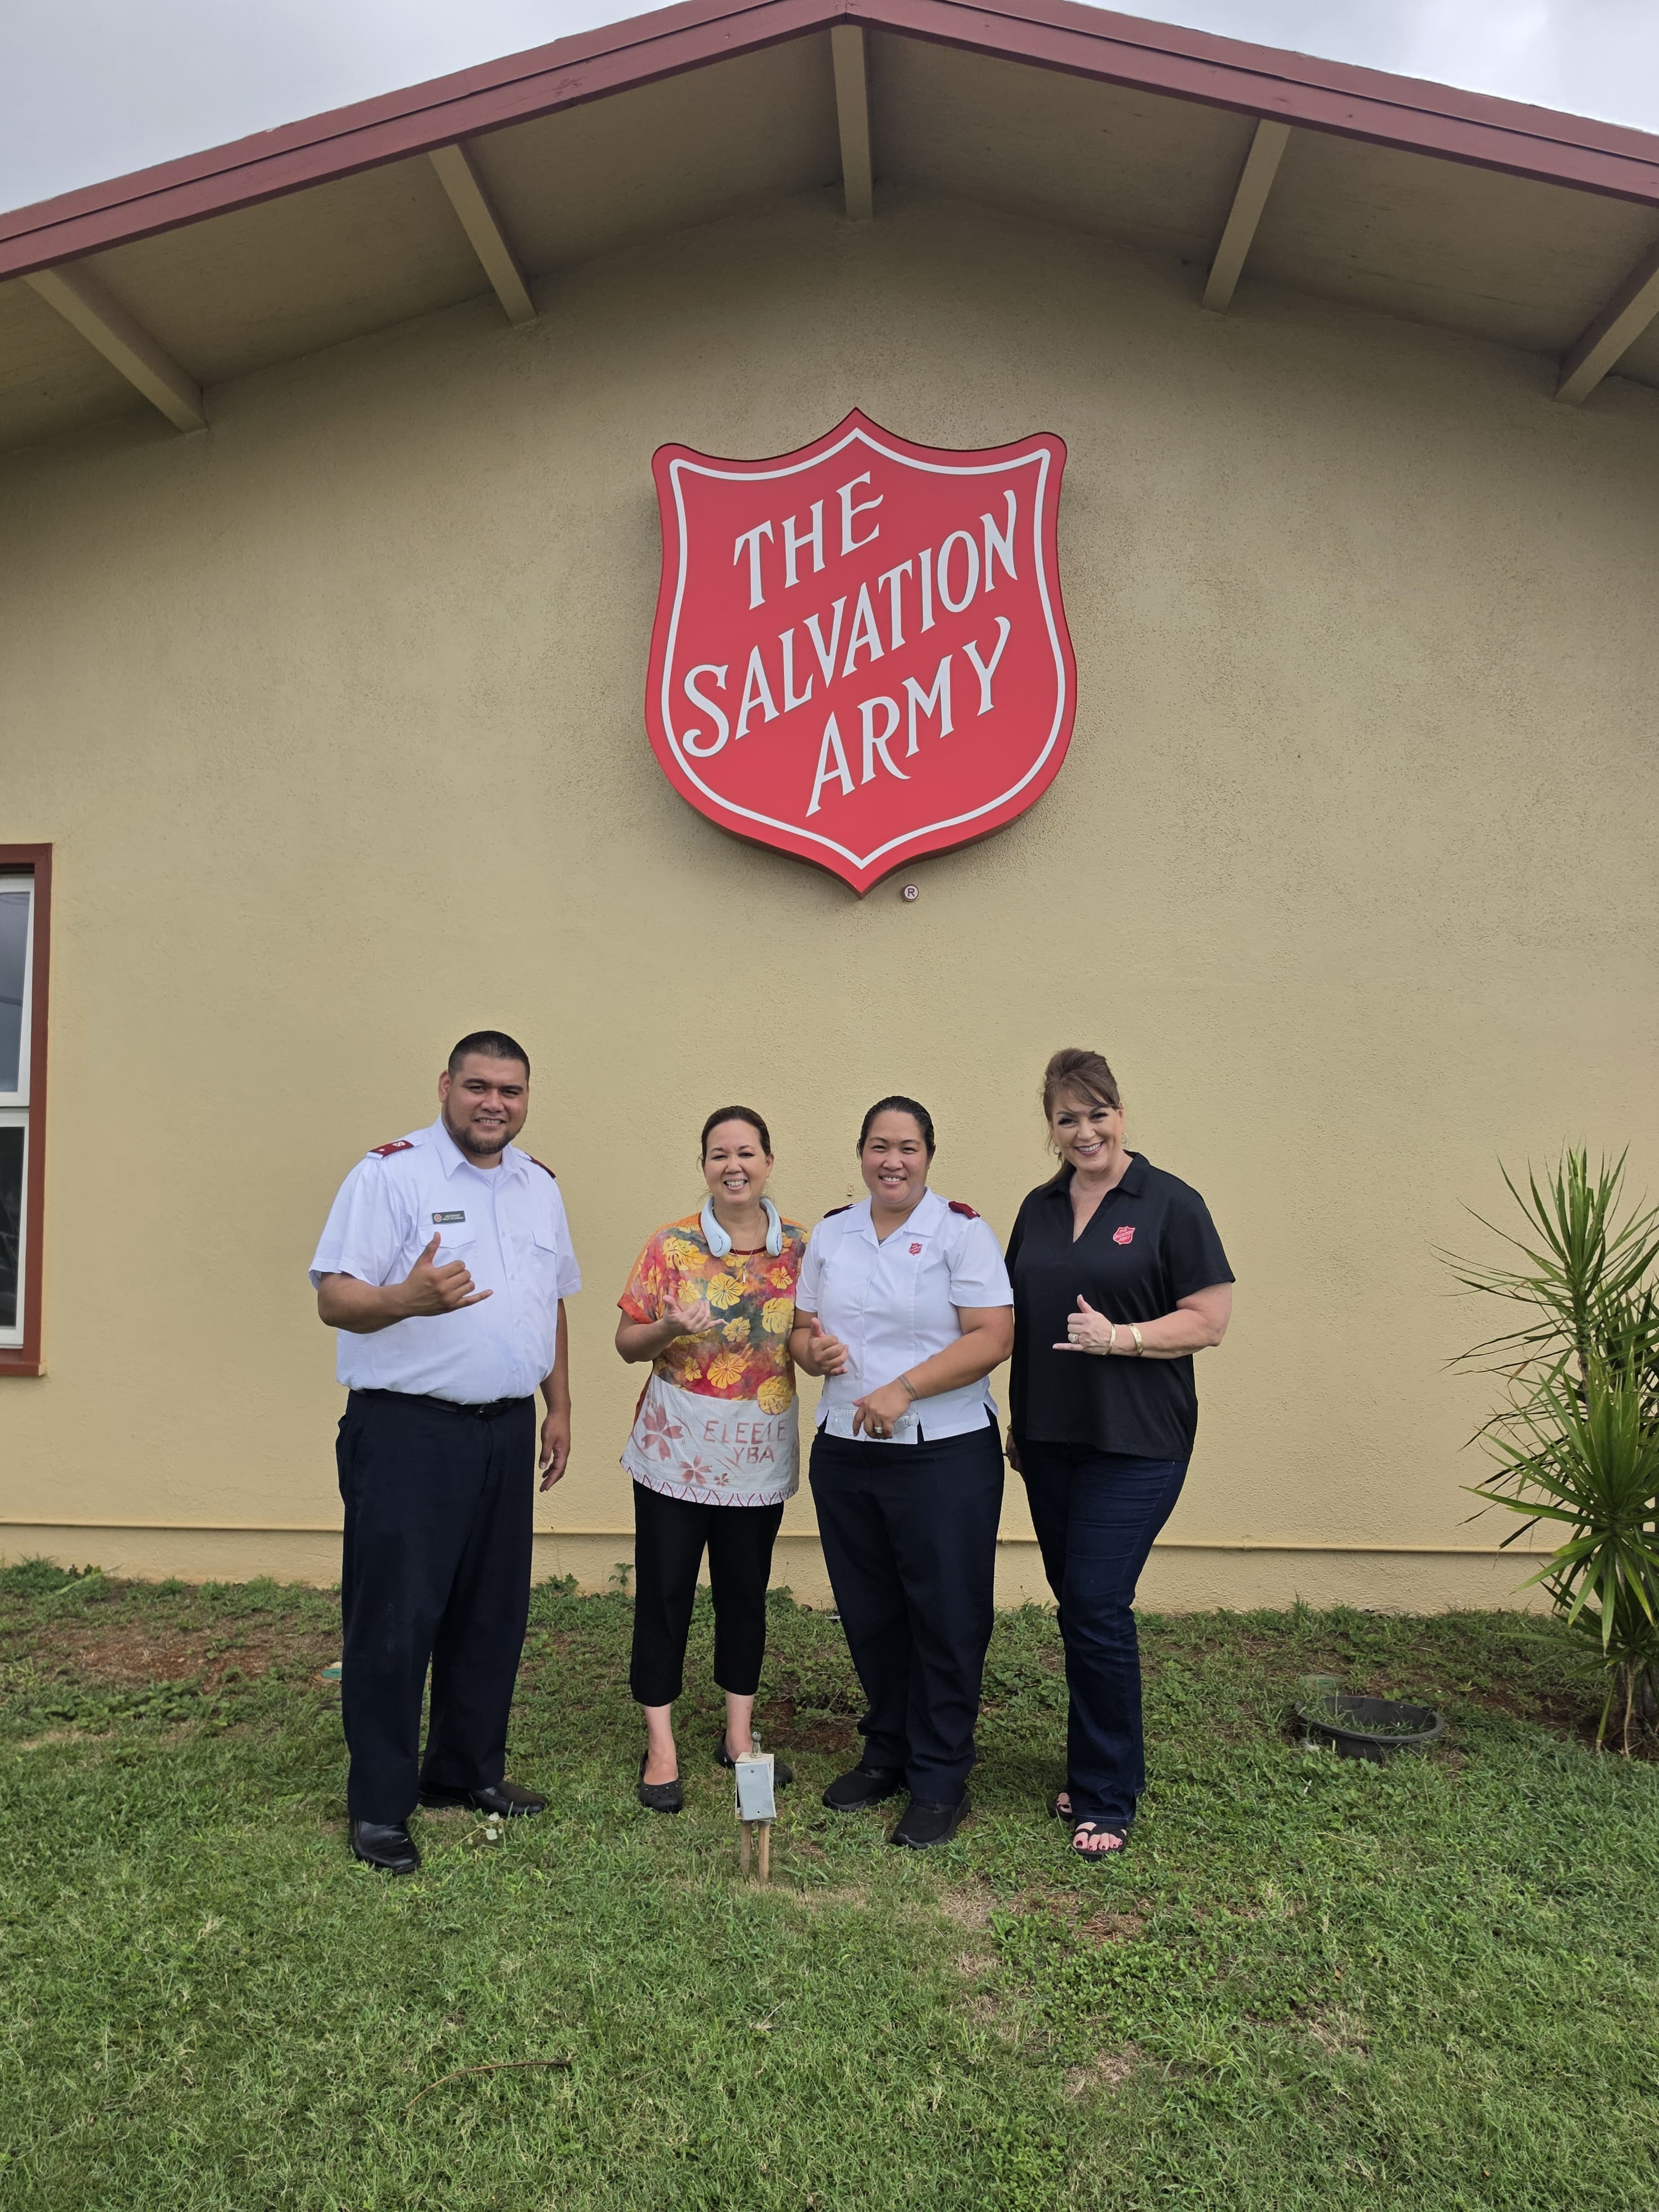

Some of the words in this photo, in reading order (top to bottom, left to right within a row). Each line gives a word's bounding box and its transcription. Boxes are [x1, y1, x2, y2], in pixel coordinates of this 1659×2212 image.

[682, 489, 1018, 758] SALVATION
[733, 471, 884, 611] THE
[806, 616, 1011, 818] ARMY
[732, 1445, 775, 1465] YBA
